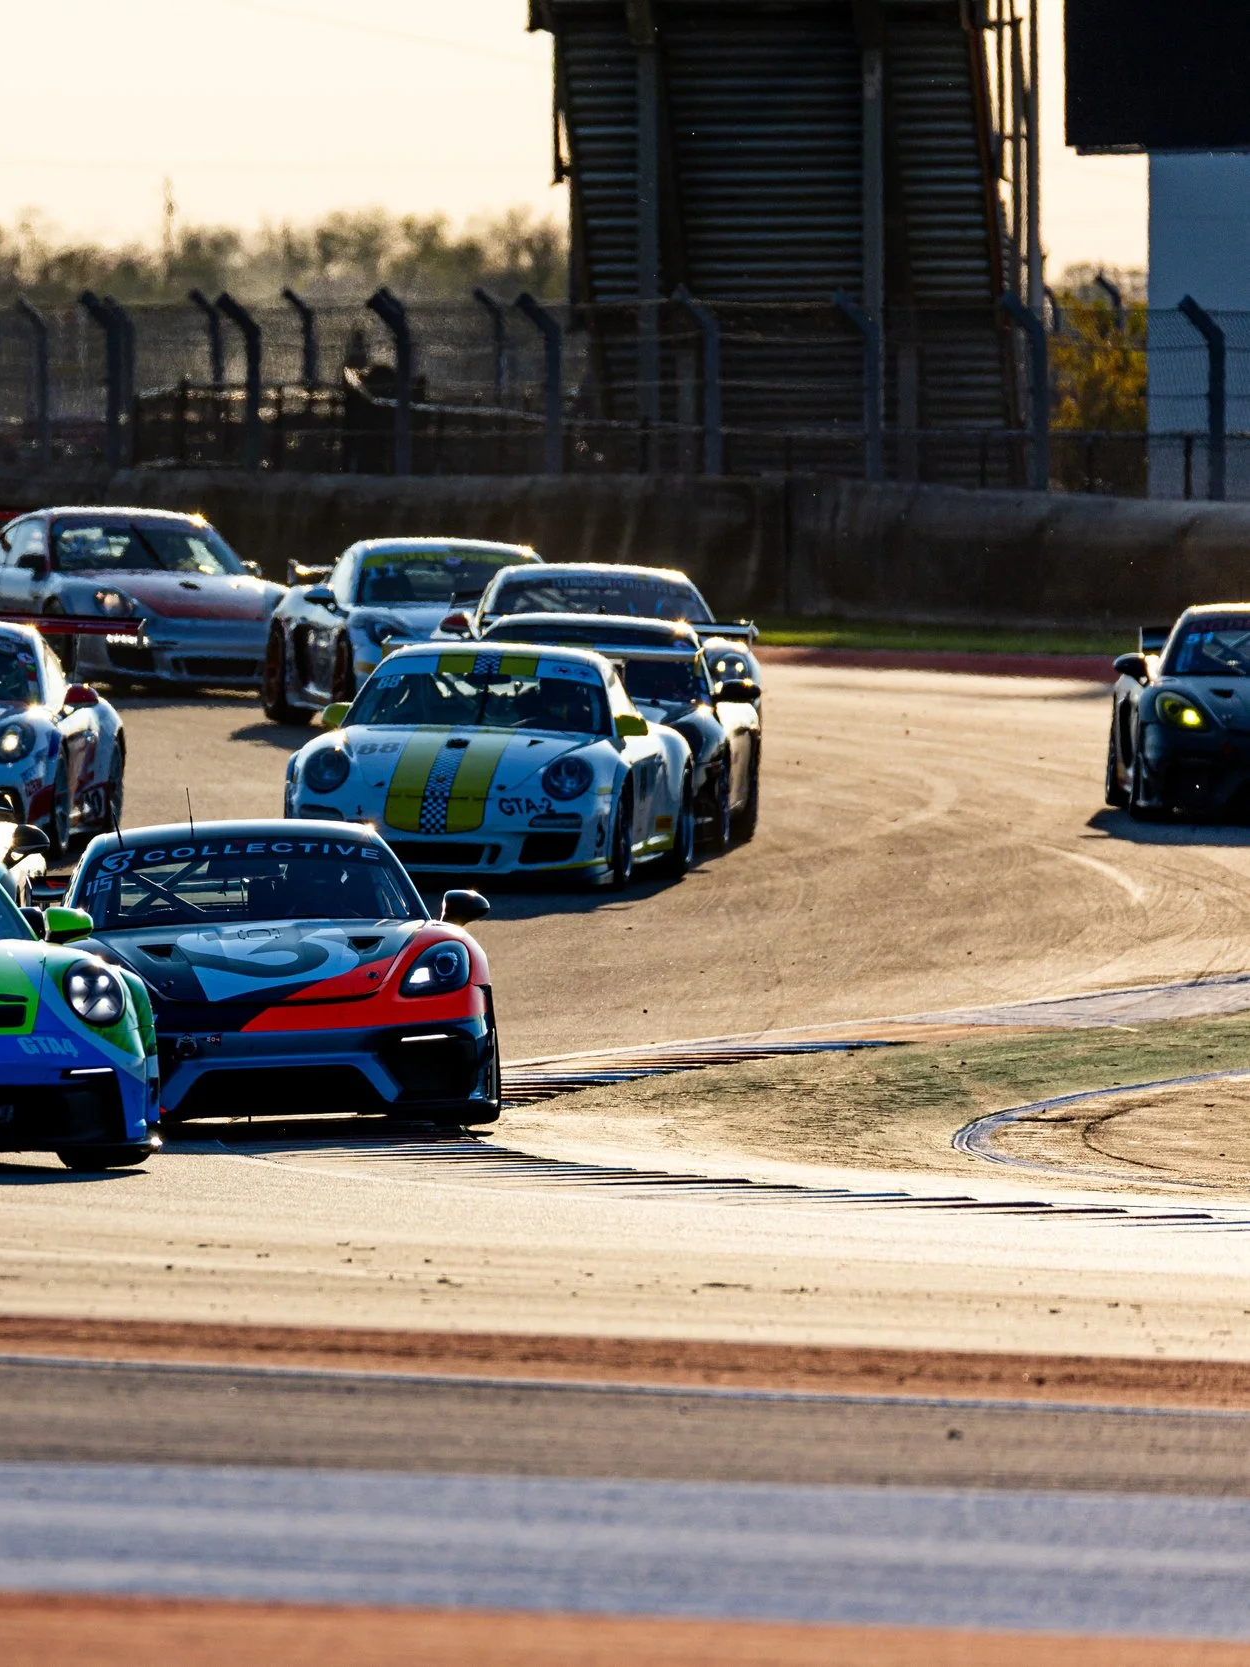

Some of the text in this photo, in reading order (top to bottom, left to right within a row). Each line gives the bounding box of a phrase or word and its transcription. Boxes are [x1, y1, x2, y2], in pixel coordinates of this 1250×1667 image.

[376, 675, 401, 690] 88
[358, 742, 402, 756] 88
[498, 798, 557, 817] GTA-2
[144, 842, 380, 861] COLLECTIVE
[86, 876, 114, 897] 115
[16, 1036, 79, 1058] GTA4
